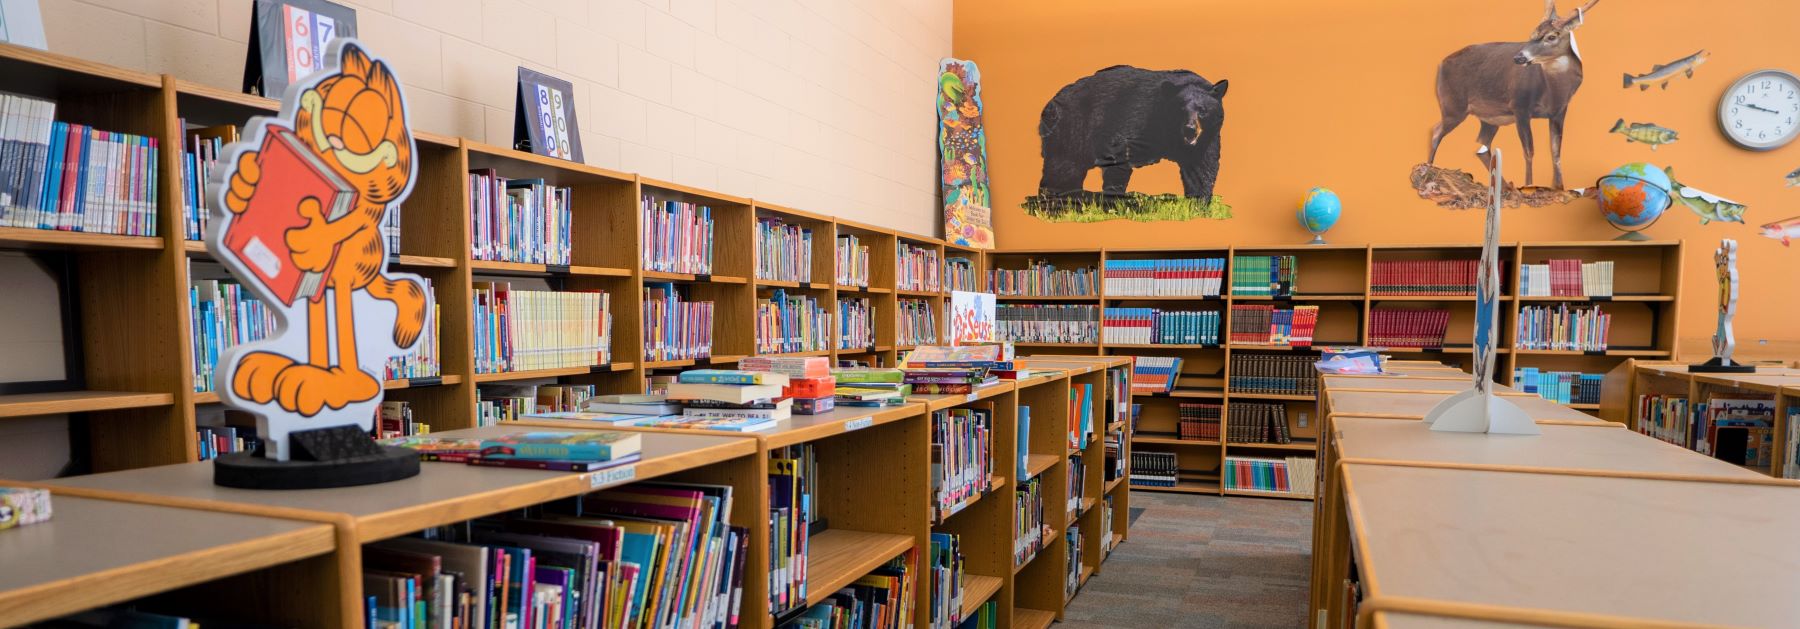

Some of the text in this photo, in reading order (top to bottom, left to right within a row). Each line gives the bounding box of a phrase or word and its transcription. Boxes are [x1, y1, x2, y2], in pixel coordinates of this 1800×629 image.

[1747, 85, 1755, 93] 11
[1761, 80, 1771, 89] 12
[1735, 95, 1745, 104] 10
[1787, 91, 1794, 99] 2
[1731, 107, 1738, 116] 9
[1735, 120, 1742, 128] 8
[1785, 116, 1792, 125] 4
[1759, 131, 1766, 139] 6
[1775, 126, 1781, 135] 5
[967, 309, 993, 341] Seuss
[607, 467, 633, 482] Fiction
